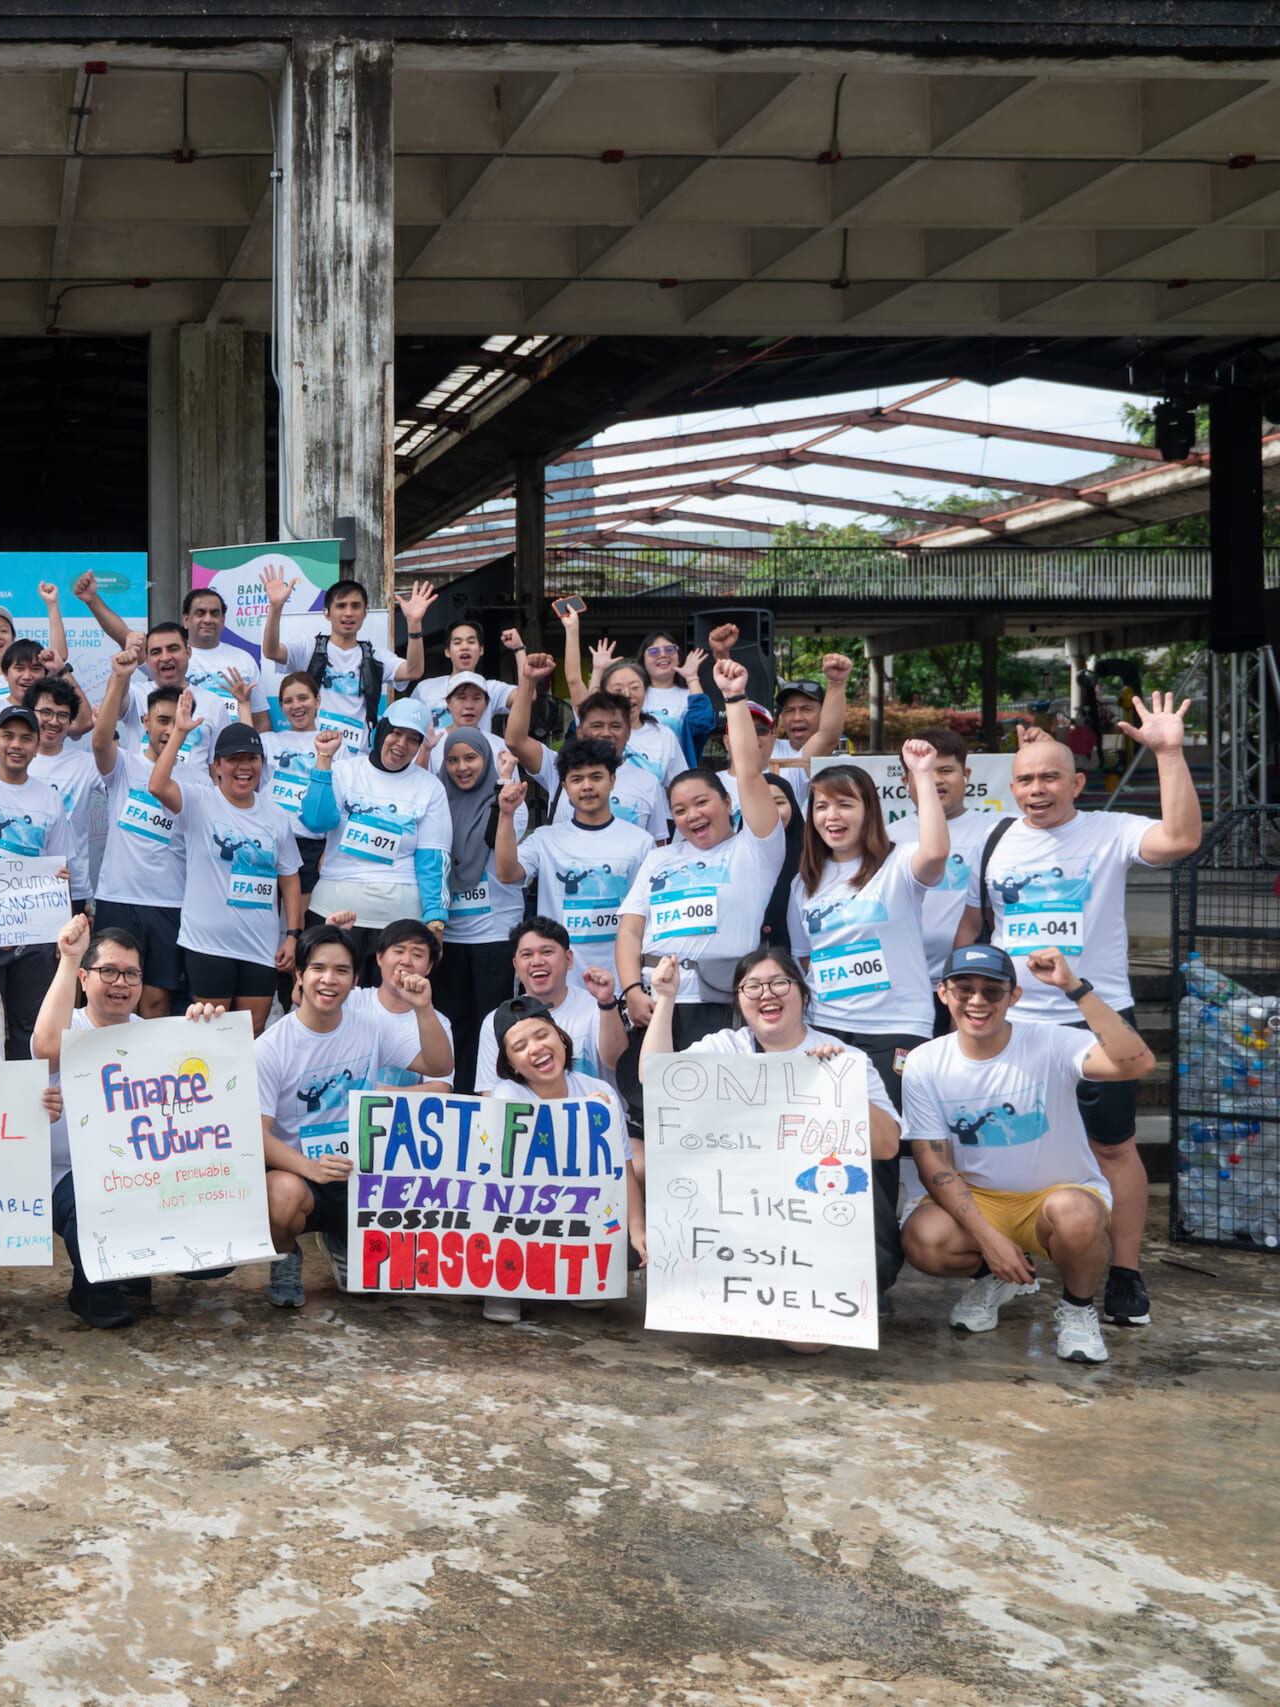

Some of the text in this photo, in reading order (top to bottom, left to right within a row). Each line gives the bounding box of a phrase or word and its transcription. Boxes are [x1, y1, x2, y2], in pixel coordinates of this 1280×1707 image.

[17, 630, 48, 638] STICE
[78, 630, 105, 638] JUST
[236, 616, 261, 628] WEE
[126, 805, 173, 830] FFA-048
[346, 828, 396, 851] FFA-071
[6, 860, 24, 872] TO
[567, 914, 618, 929] FFA-076
[656, 904, 713, 925] FFA-008
[1008, 920, 1078, 937] FFA-041
[819, 958, 883, 983] FFA-006
[662, 1057, 856, 1108] ONLY
[161, 1090, 194, 1117] the
[127, 1114, 233, 1161] future
[358, 1095, 623, 1180] FAST, FAIR,
[657, 1106, 867, 1157] FOSSIL FOOLS
[103, 1162, 231, 1192] choose renewable
[161, 1194, 185, 1208] NOT
[357, 1210, 591, 1238] FOSSIL FUEL
